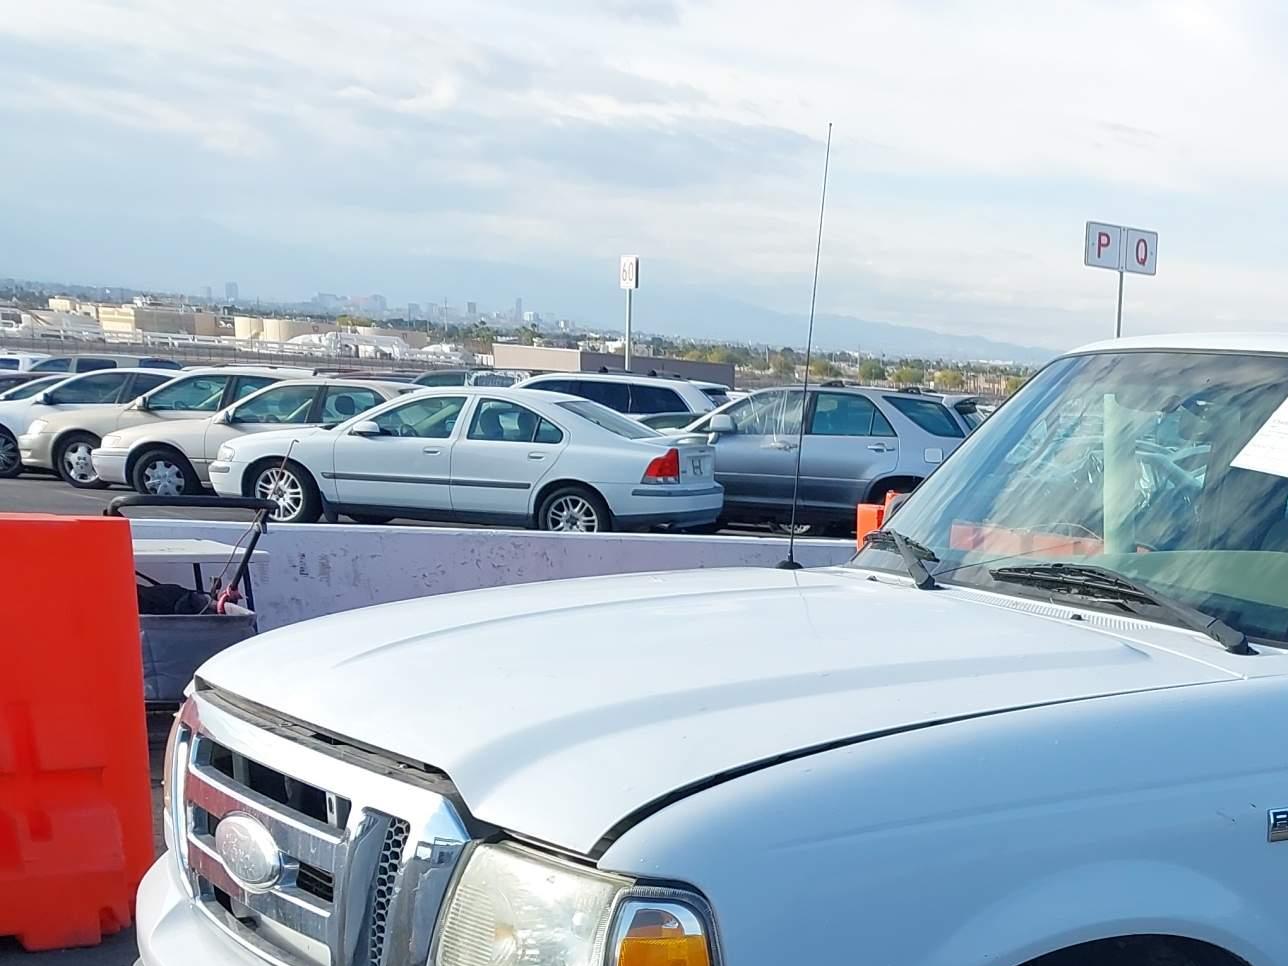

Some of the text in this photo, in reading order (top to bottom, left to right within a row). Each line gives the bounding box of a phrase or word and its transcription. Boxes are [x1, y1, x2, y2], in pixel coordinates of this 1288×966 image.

[1096, 231, 1148, 267] P Q
[622, 261, 634, 282] 60
